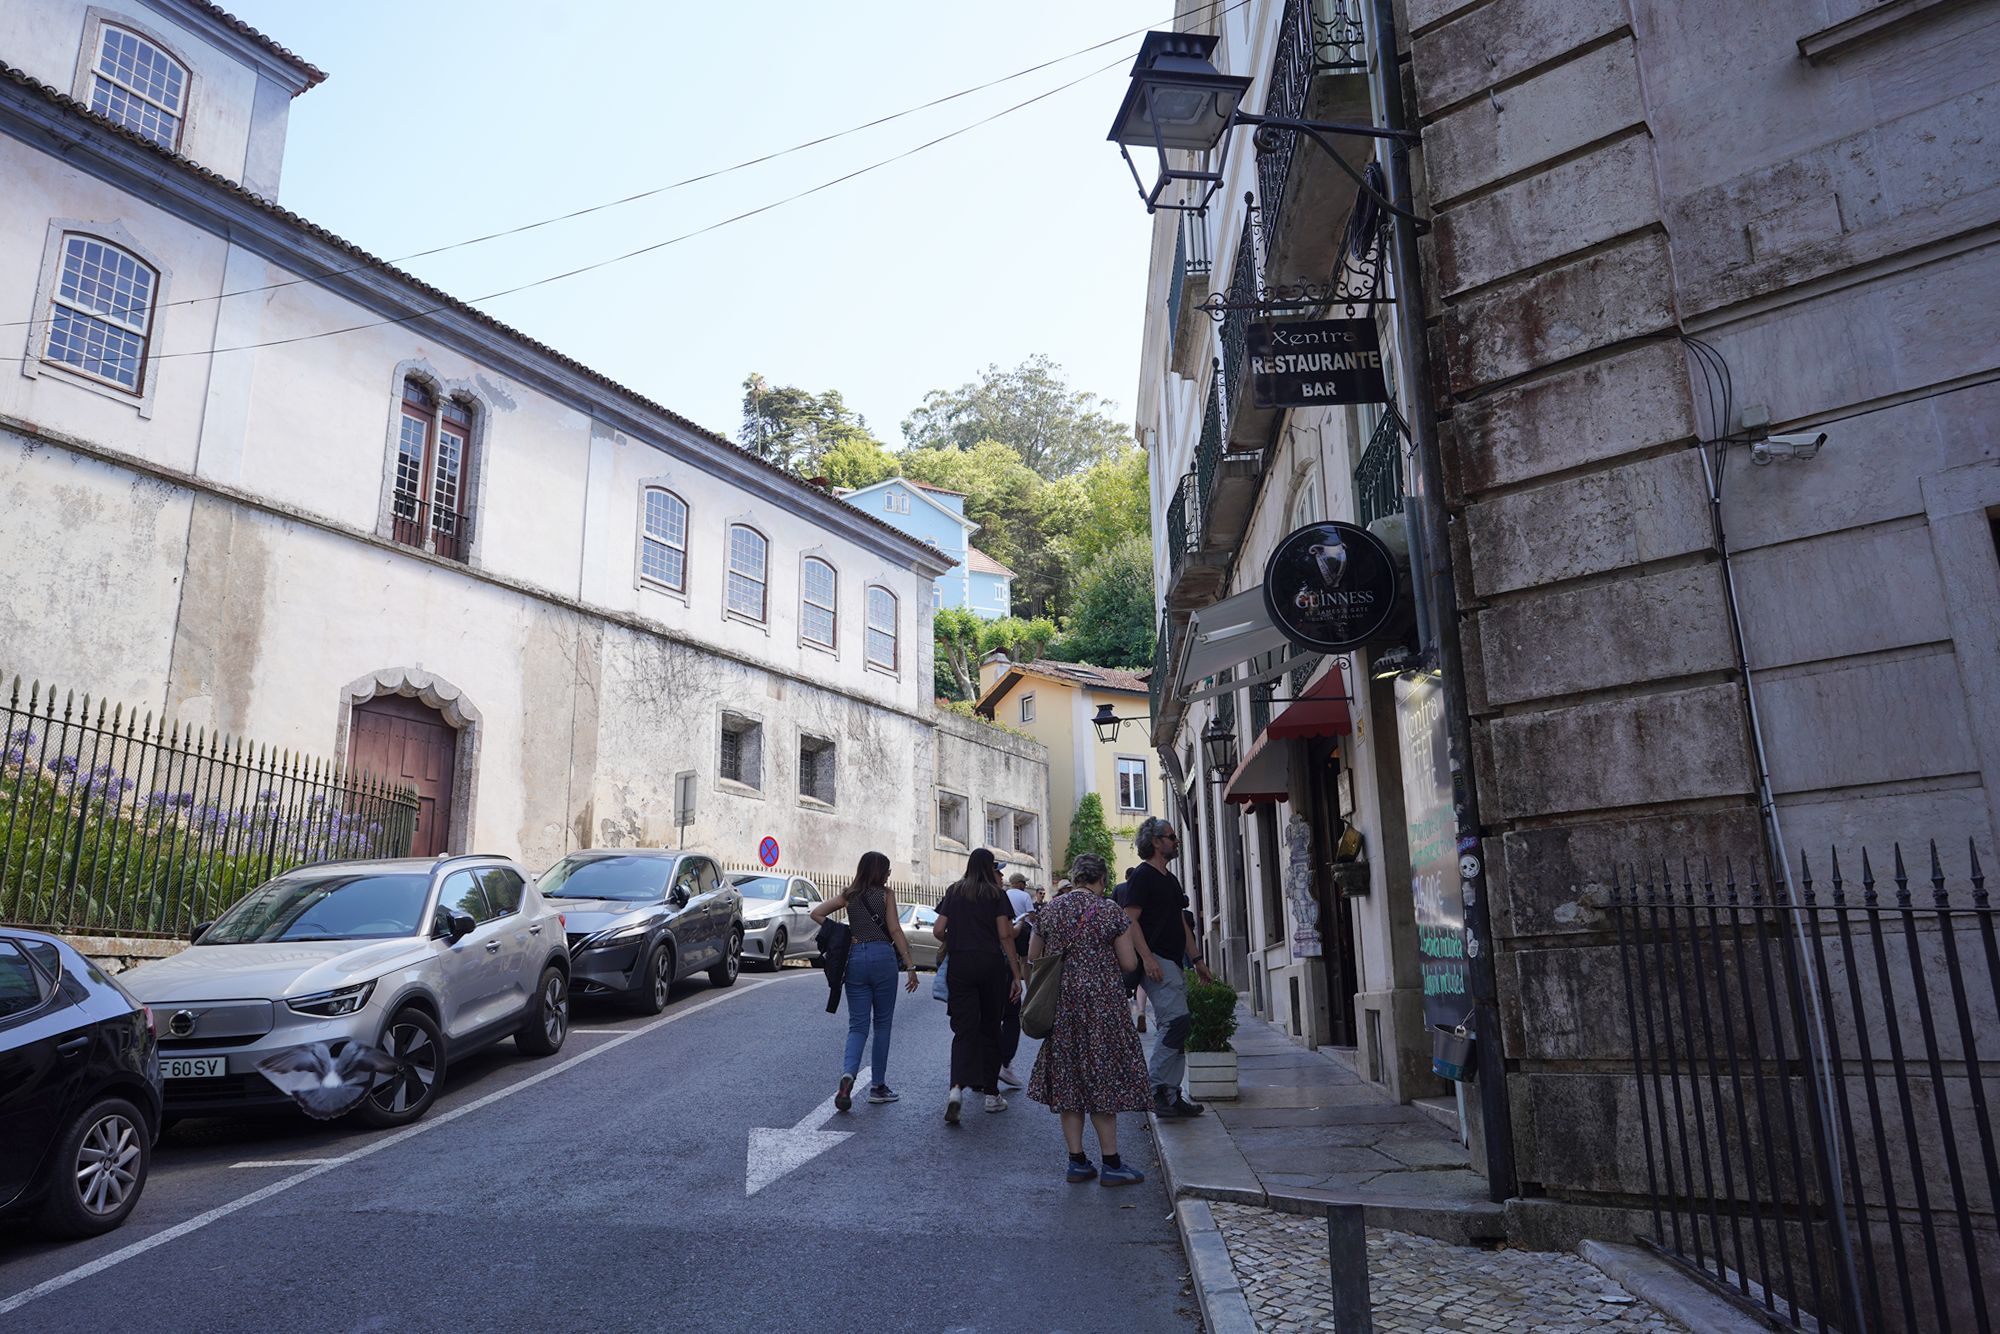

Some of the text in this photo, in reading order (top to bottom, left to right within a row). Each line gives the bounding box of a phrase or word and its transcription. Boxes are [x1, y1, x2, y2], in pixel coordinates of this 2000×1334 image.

[1271, 330, 1357, 347] Xentra
[1251, 351, 1381, 374] RESTAURANTE
[1302, 382, 1337, 398] BAR
[1295, 590, 1375, 609] GUINNESS
